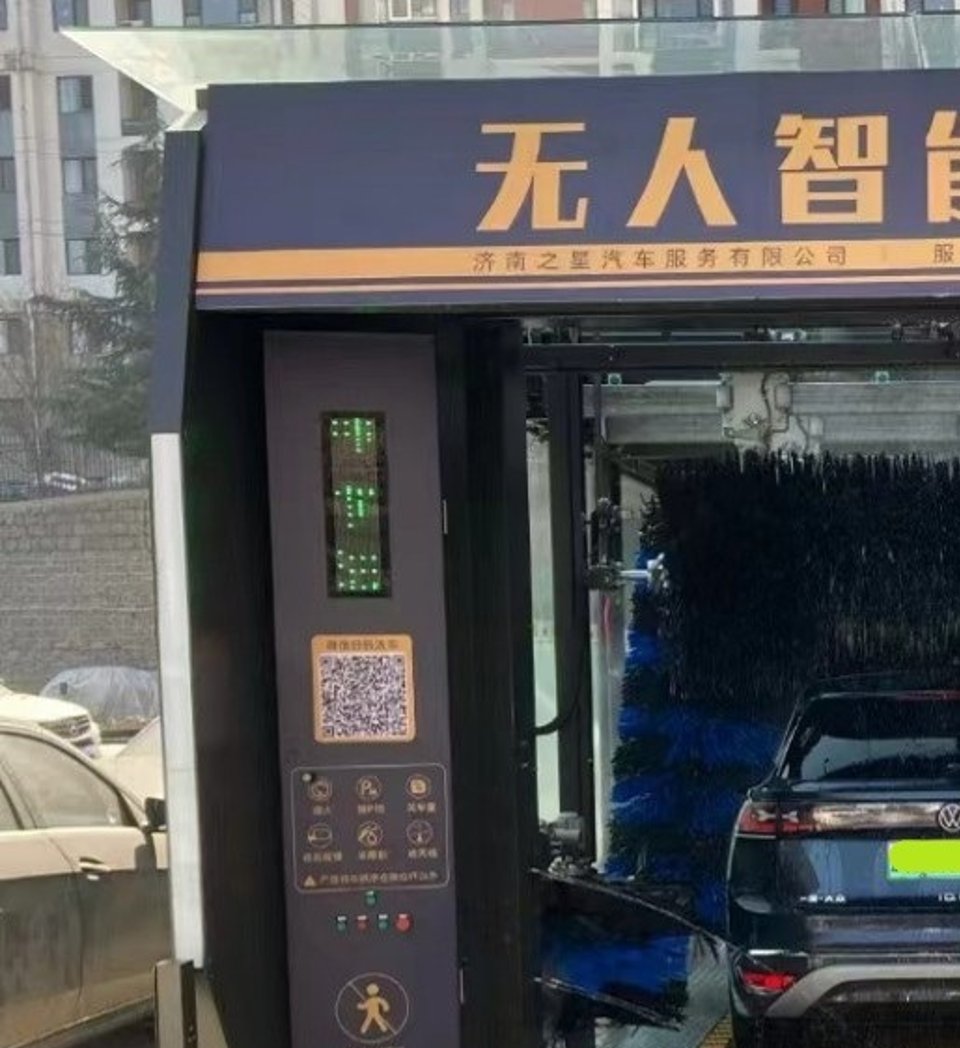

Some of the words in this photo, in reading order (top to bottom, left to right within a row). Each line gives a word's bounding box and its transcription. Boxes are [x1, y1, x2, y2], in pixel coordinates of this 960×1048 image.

[472, 245, 848, 272] 济南之星汽车服务有限公司
